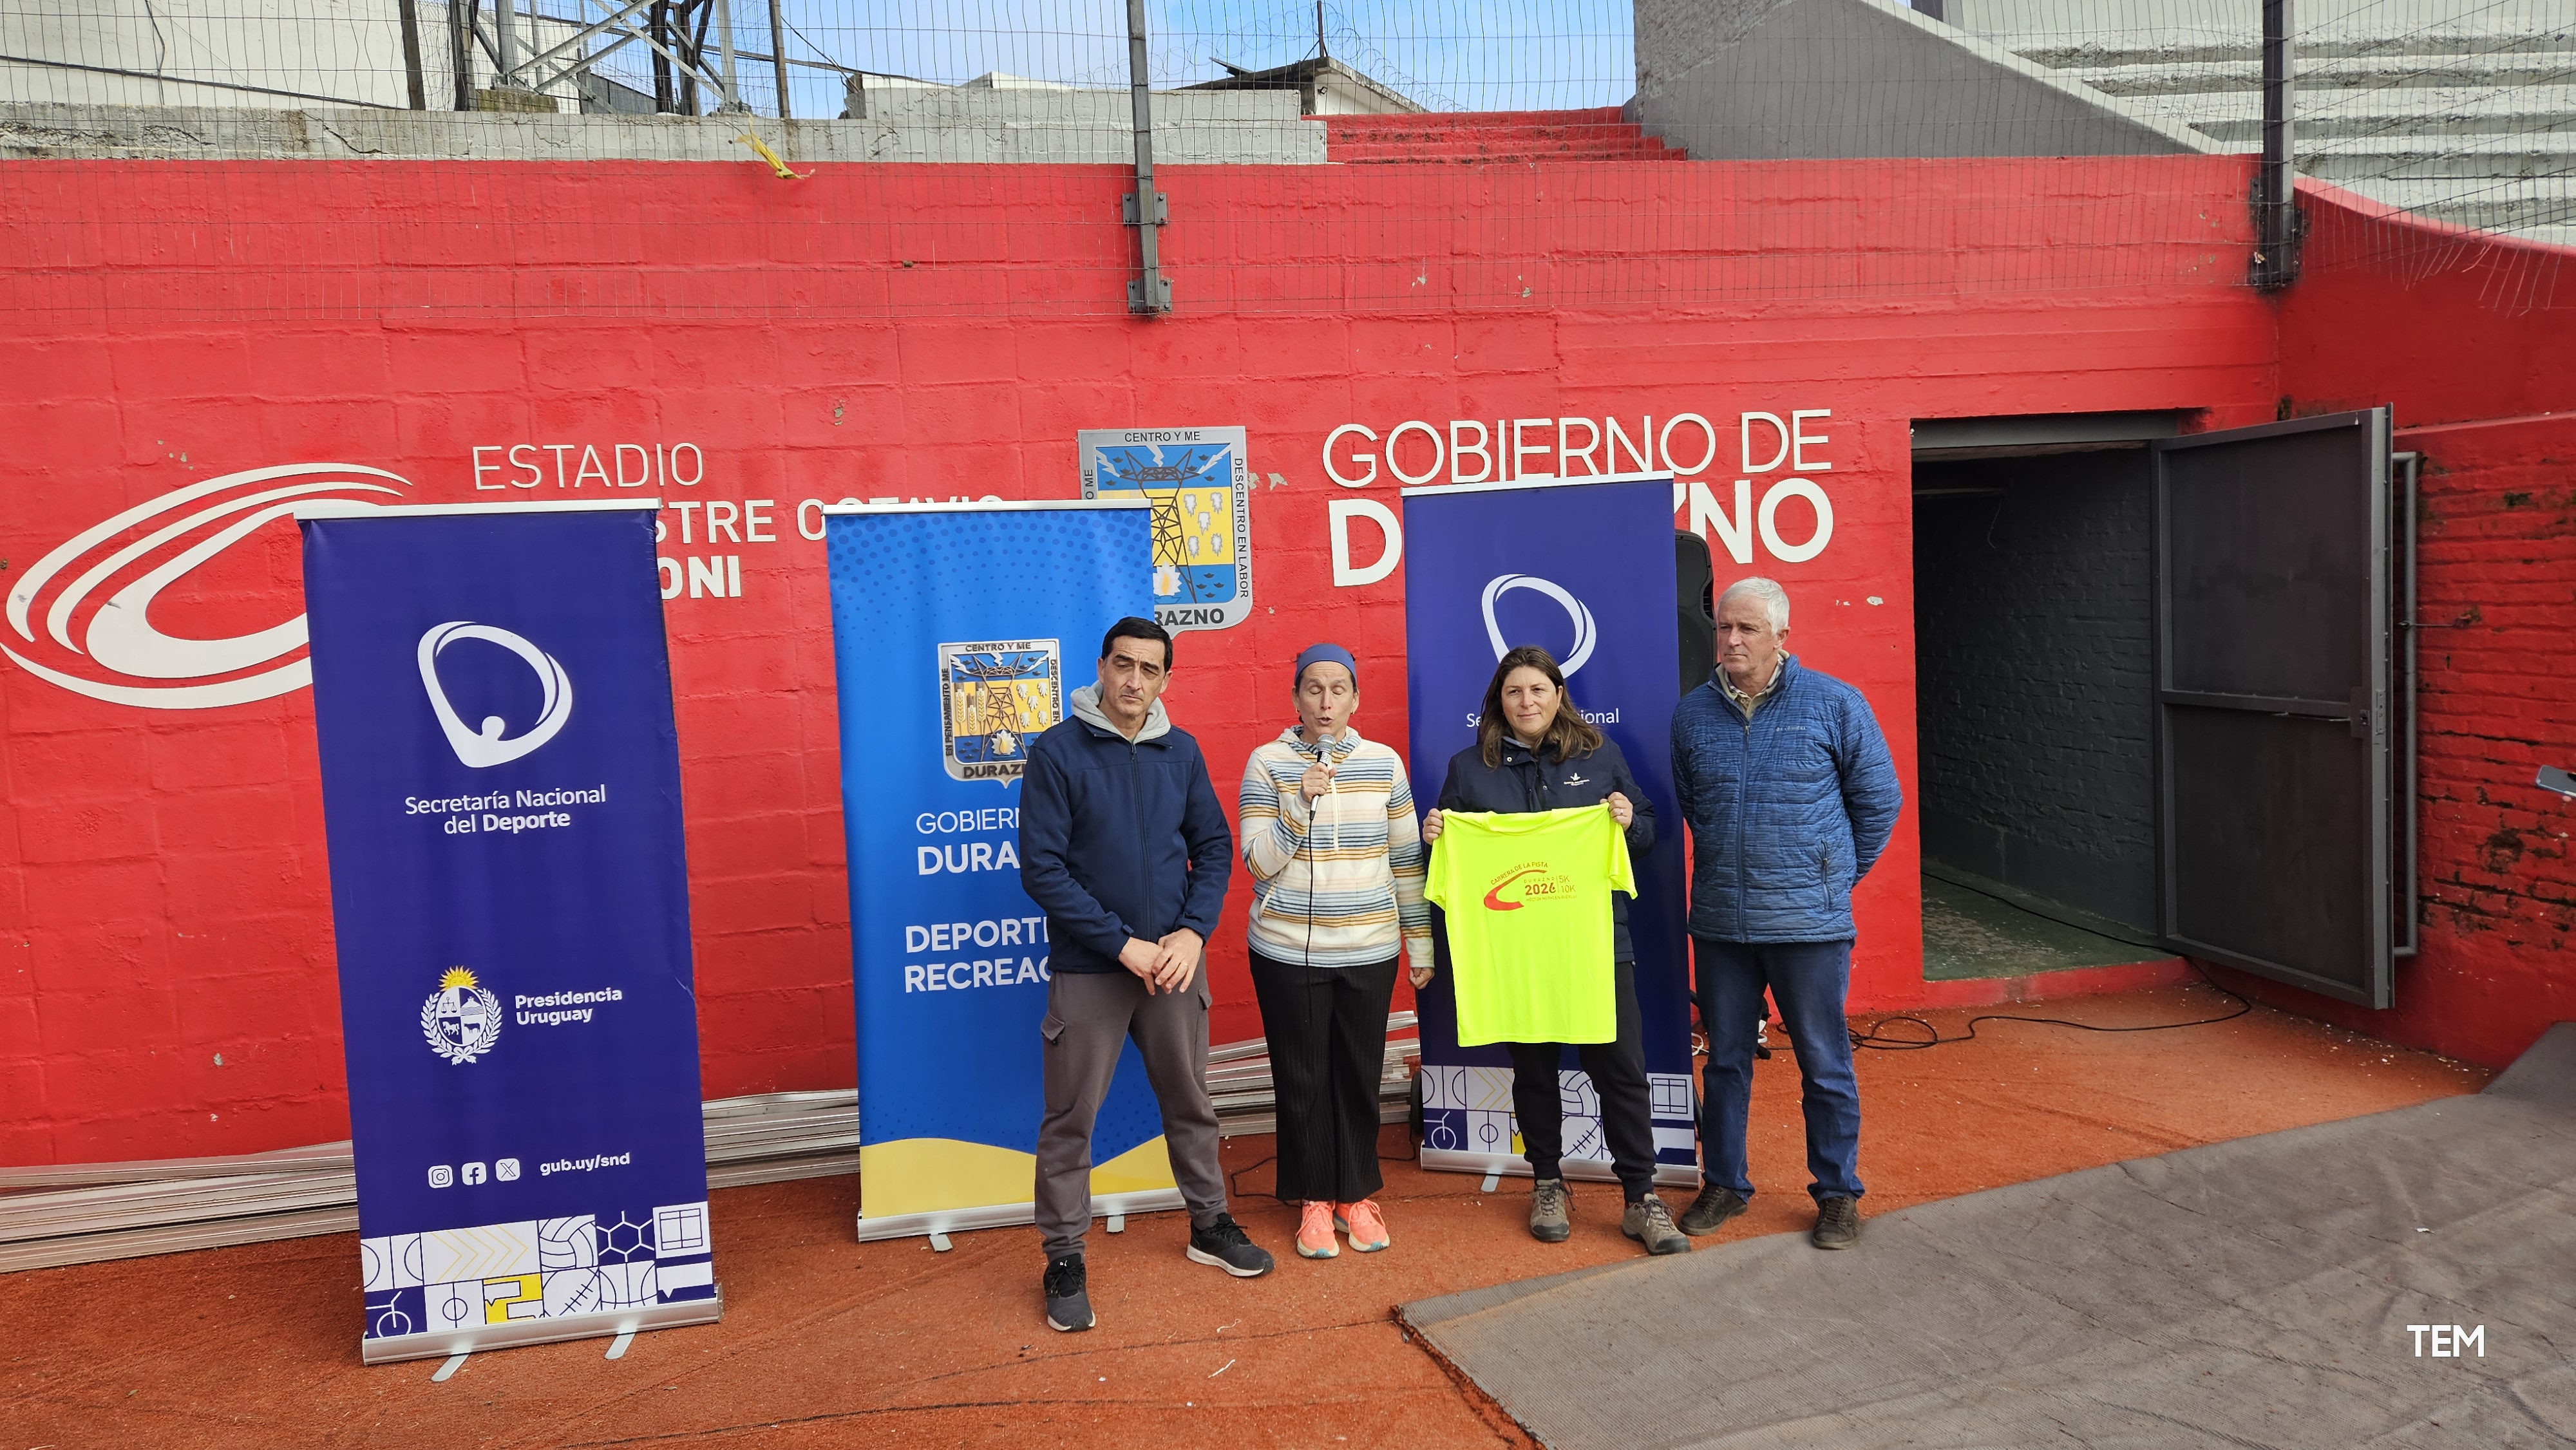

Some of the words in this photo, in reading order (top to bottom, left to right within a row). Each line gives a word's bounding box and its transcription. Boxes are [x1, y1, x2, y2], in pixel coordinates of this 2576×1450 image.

[1124, 431, 1171, 442] CENTRO
[1173, 432, 1182, 441] Y
[1184, 431, 1200, 441] ME
[1322, 412, 1716, 487] GOBIERNO
[1741, 408, 1832, 473] DE
[473, 442, 704, 490] ESTADIO
[1084, 469, 1094, 487] ME
[1234, 458, 1246, 533] DESCENTRO
[1237, 536, 1247, 552] EN
[1238, 555, 1249, 599] LABOR
[965, 643, 1005, 652] CENTRO
[1016, 641, 1032, 650] ME
[942, 667, 950, 682] ME
[1050, 659, 1059, 709] DESCENTRO
[942, 683, 953, 744] PENSAMIENTO
[1052, 711, 1060, 722] EN
[1580, 708, 1619, 724] ional
[945, 744, 954, 757] EN
[963, 763, 1024, 778] DURAZ
[404, 790, 510, 814] Secretaría
[515, 784, 607, 808] Nacional
[444, 814, 476, 834] del
[482, 811, 571, 834] Deporte
[916, 807, 1019, 834] GOBIER
[917, 841, 1021, 876] DURA
[1490, 869, 1515, 885] CARRERA
[1559, 875, 1570, 883] 5K
[1524, 882, 1556, 896] 2026
[1561, 885, 1576, 893] 10K
[515, 986, 623, 1009] Presidencia
[516, 1007, 593, 1026] Uruguay
[539, 1152, 630, 1176] gub.uy/snd
